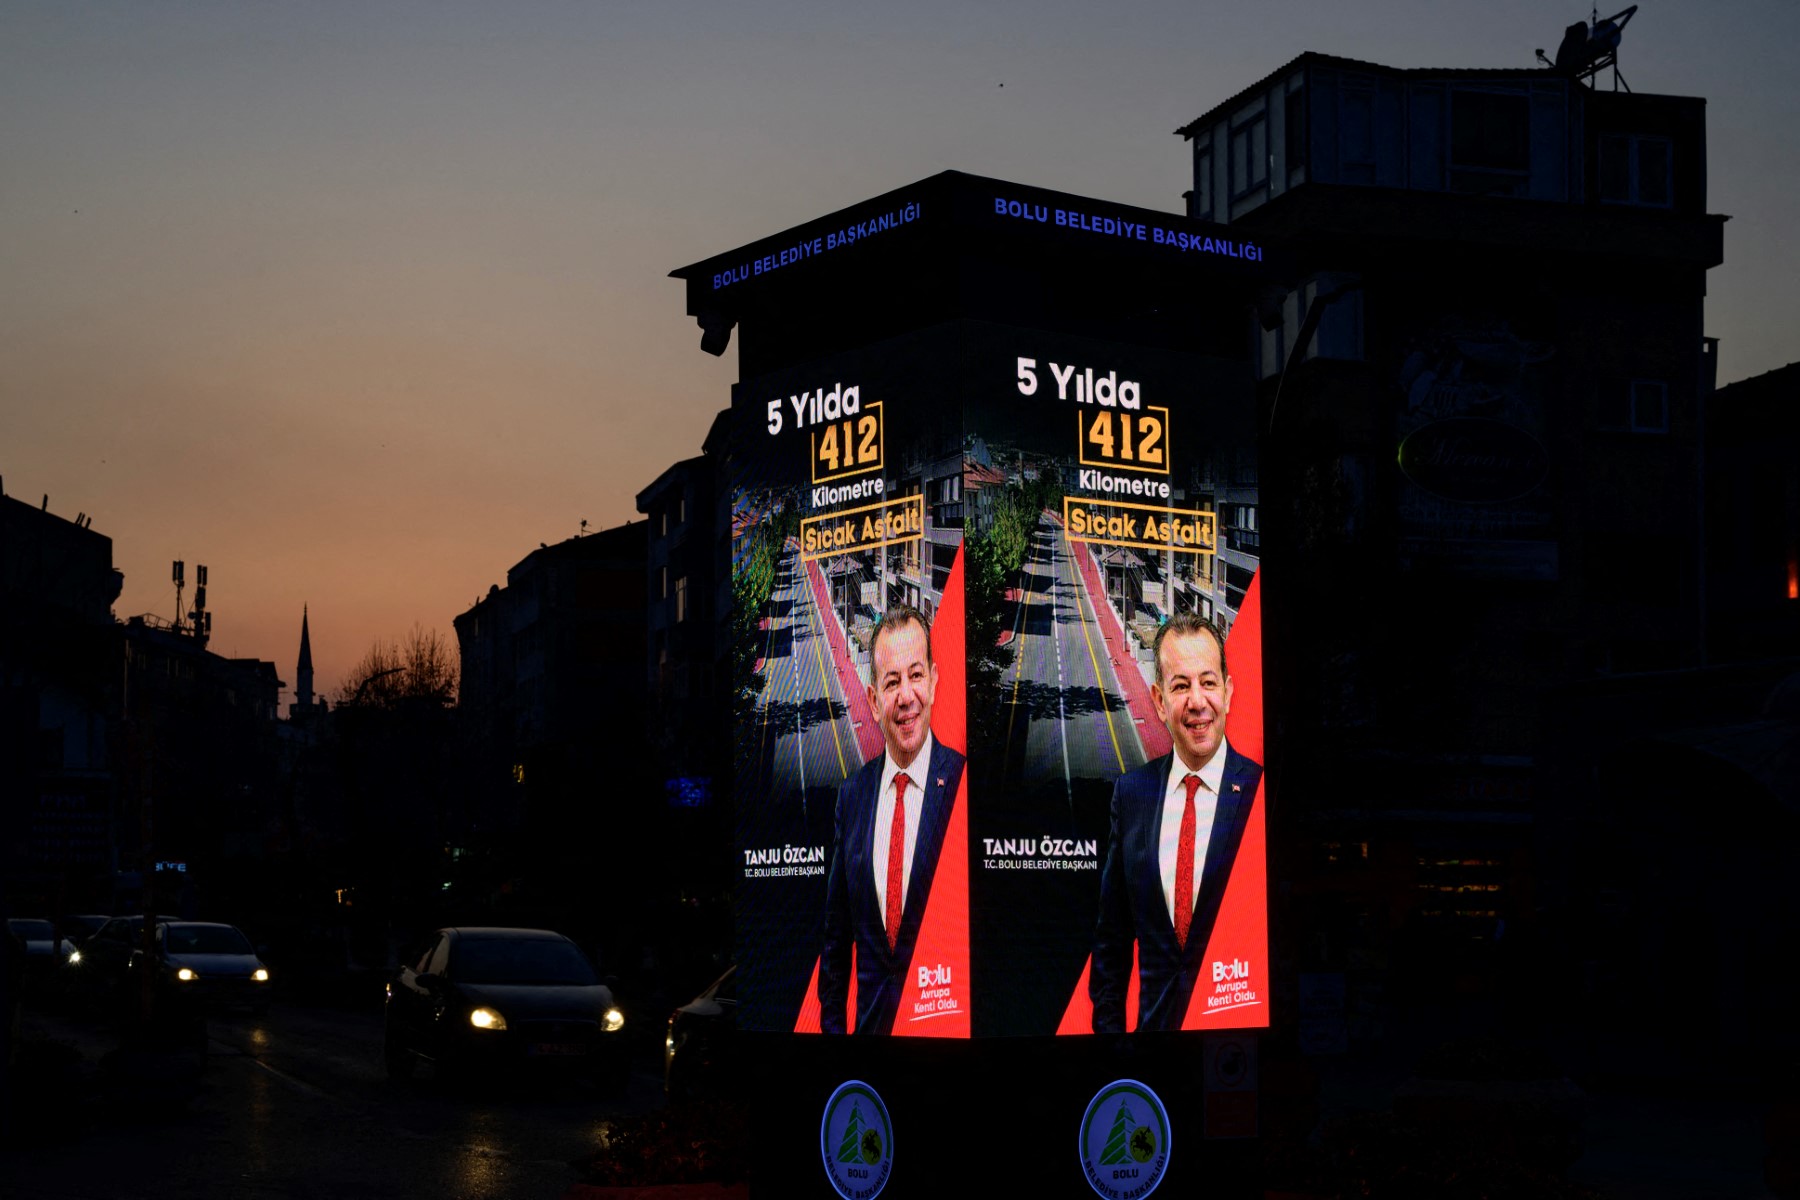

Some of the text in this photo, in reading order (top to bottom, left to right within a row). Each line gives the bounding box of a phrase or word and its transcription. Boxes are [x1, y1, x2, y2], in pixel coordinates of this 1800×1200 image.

[994, 197, 1263, 262] BOLU BELEDİYE BAŞKANLIĞI
[713, 202, 921, 290] BOLU BELEDİYE BAŞKANLIĞI
[1017, 356, 1141, 410] 5 Yılda
[767, 382, 860, 436] 5 Yılda
[819, 415, 878, 471] 412
[1089, 410, 1163, 464] 412
[811, 477, 884, 509] Kilometre
[1079, 469, 1170, 499] Kilometre
[805, 507, 919, 552] Sıcak Asfalt
[1071, 508, 1212, 546] Sıcak Asfalt
[744, 843, 825, 866] TANJU ÖZCAN
[983, 834, 1098, 857] TANJU ÖZCAN
[754, 867, 771, 878] BOLU
[771, 865, 799, 877] BELEDİYE
[799, 865, 825, 878] BAŞKANI
[983, 858, 1098, 872] T.C. BOLU BELEDİYE BAŞKANI
[920, 988, 950, 1000] Avrupa
[1207, 990, 1256, 1007] Kenti Oldu
[1215, 980, 1248, 994] Avrupa
[914, 998, 958, 1014] Kenti Oldu
[847, 1168, 869, 1179] BOLU
[1112, 1168, 1140, 1180] BOLU
